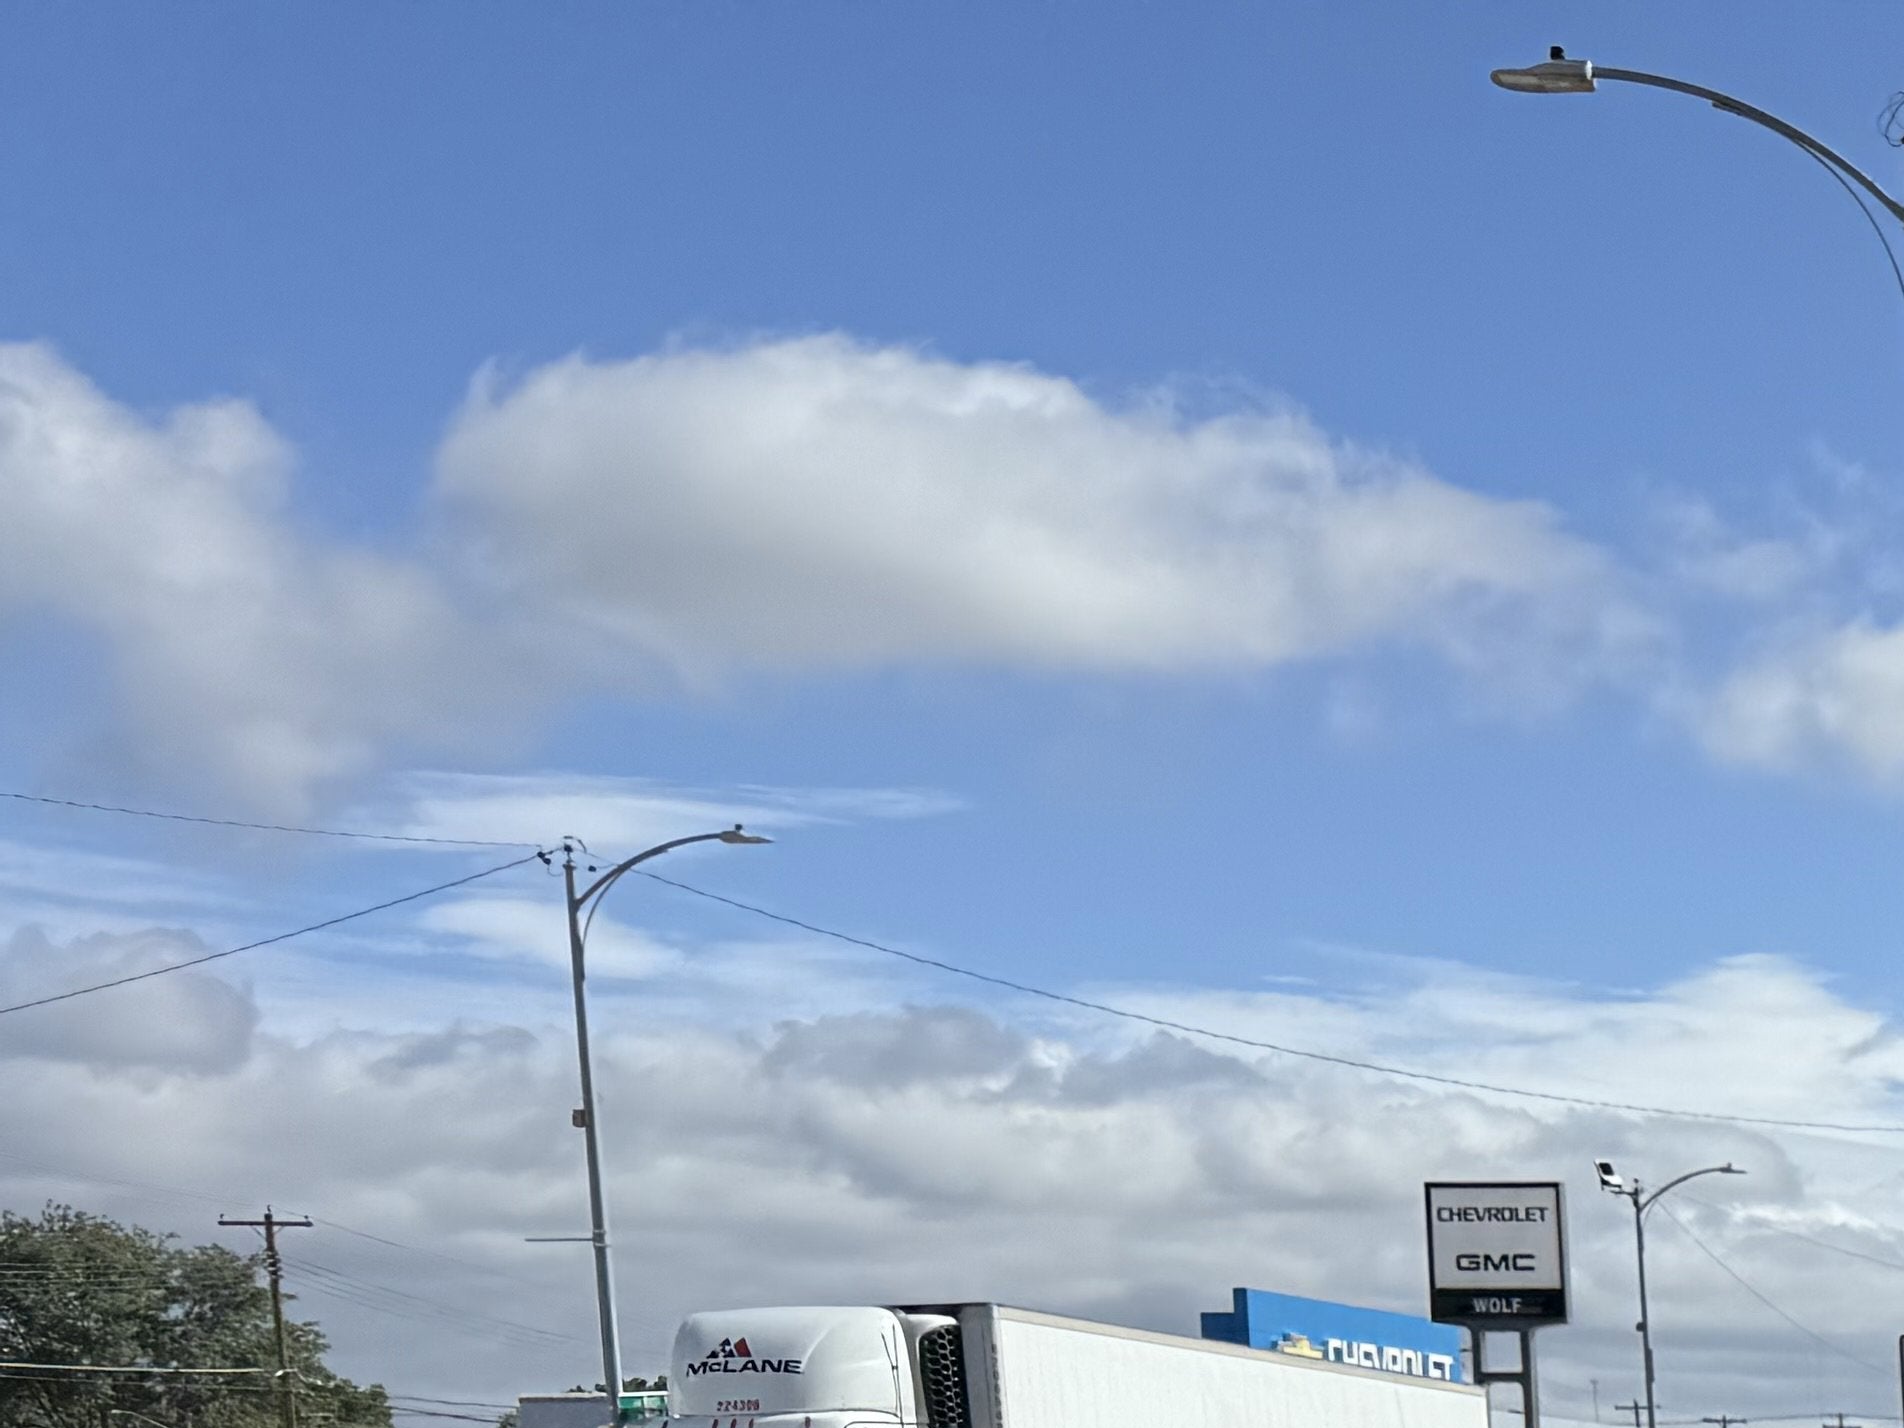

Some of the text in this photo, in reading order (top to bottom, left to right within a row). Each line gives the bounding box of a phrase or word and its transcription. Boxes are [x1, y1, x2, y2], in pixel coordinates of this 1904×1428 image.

[1436, 1206, 1549, 1222] CHEVROLET
[1456, 1253, 1536, 1271] GMC
[1472, 1297, 1522, 1314] WOLF
[686, 1359, 804, 1377] McLANE
